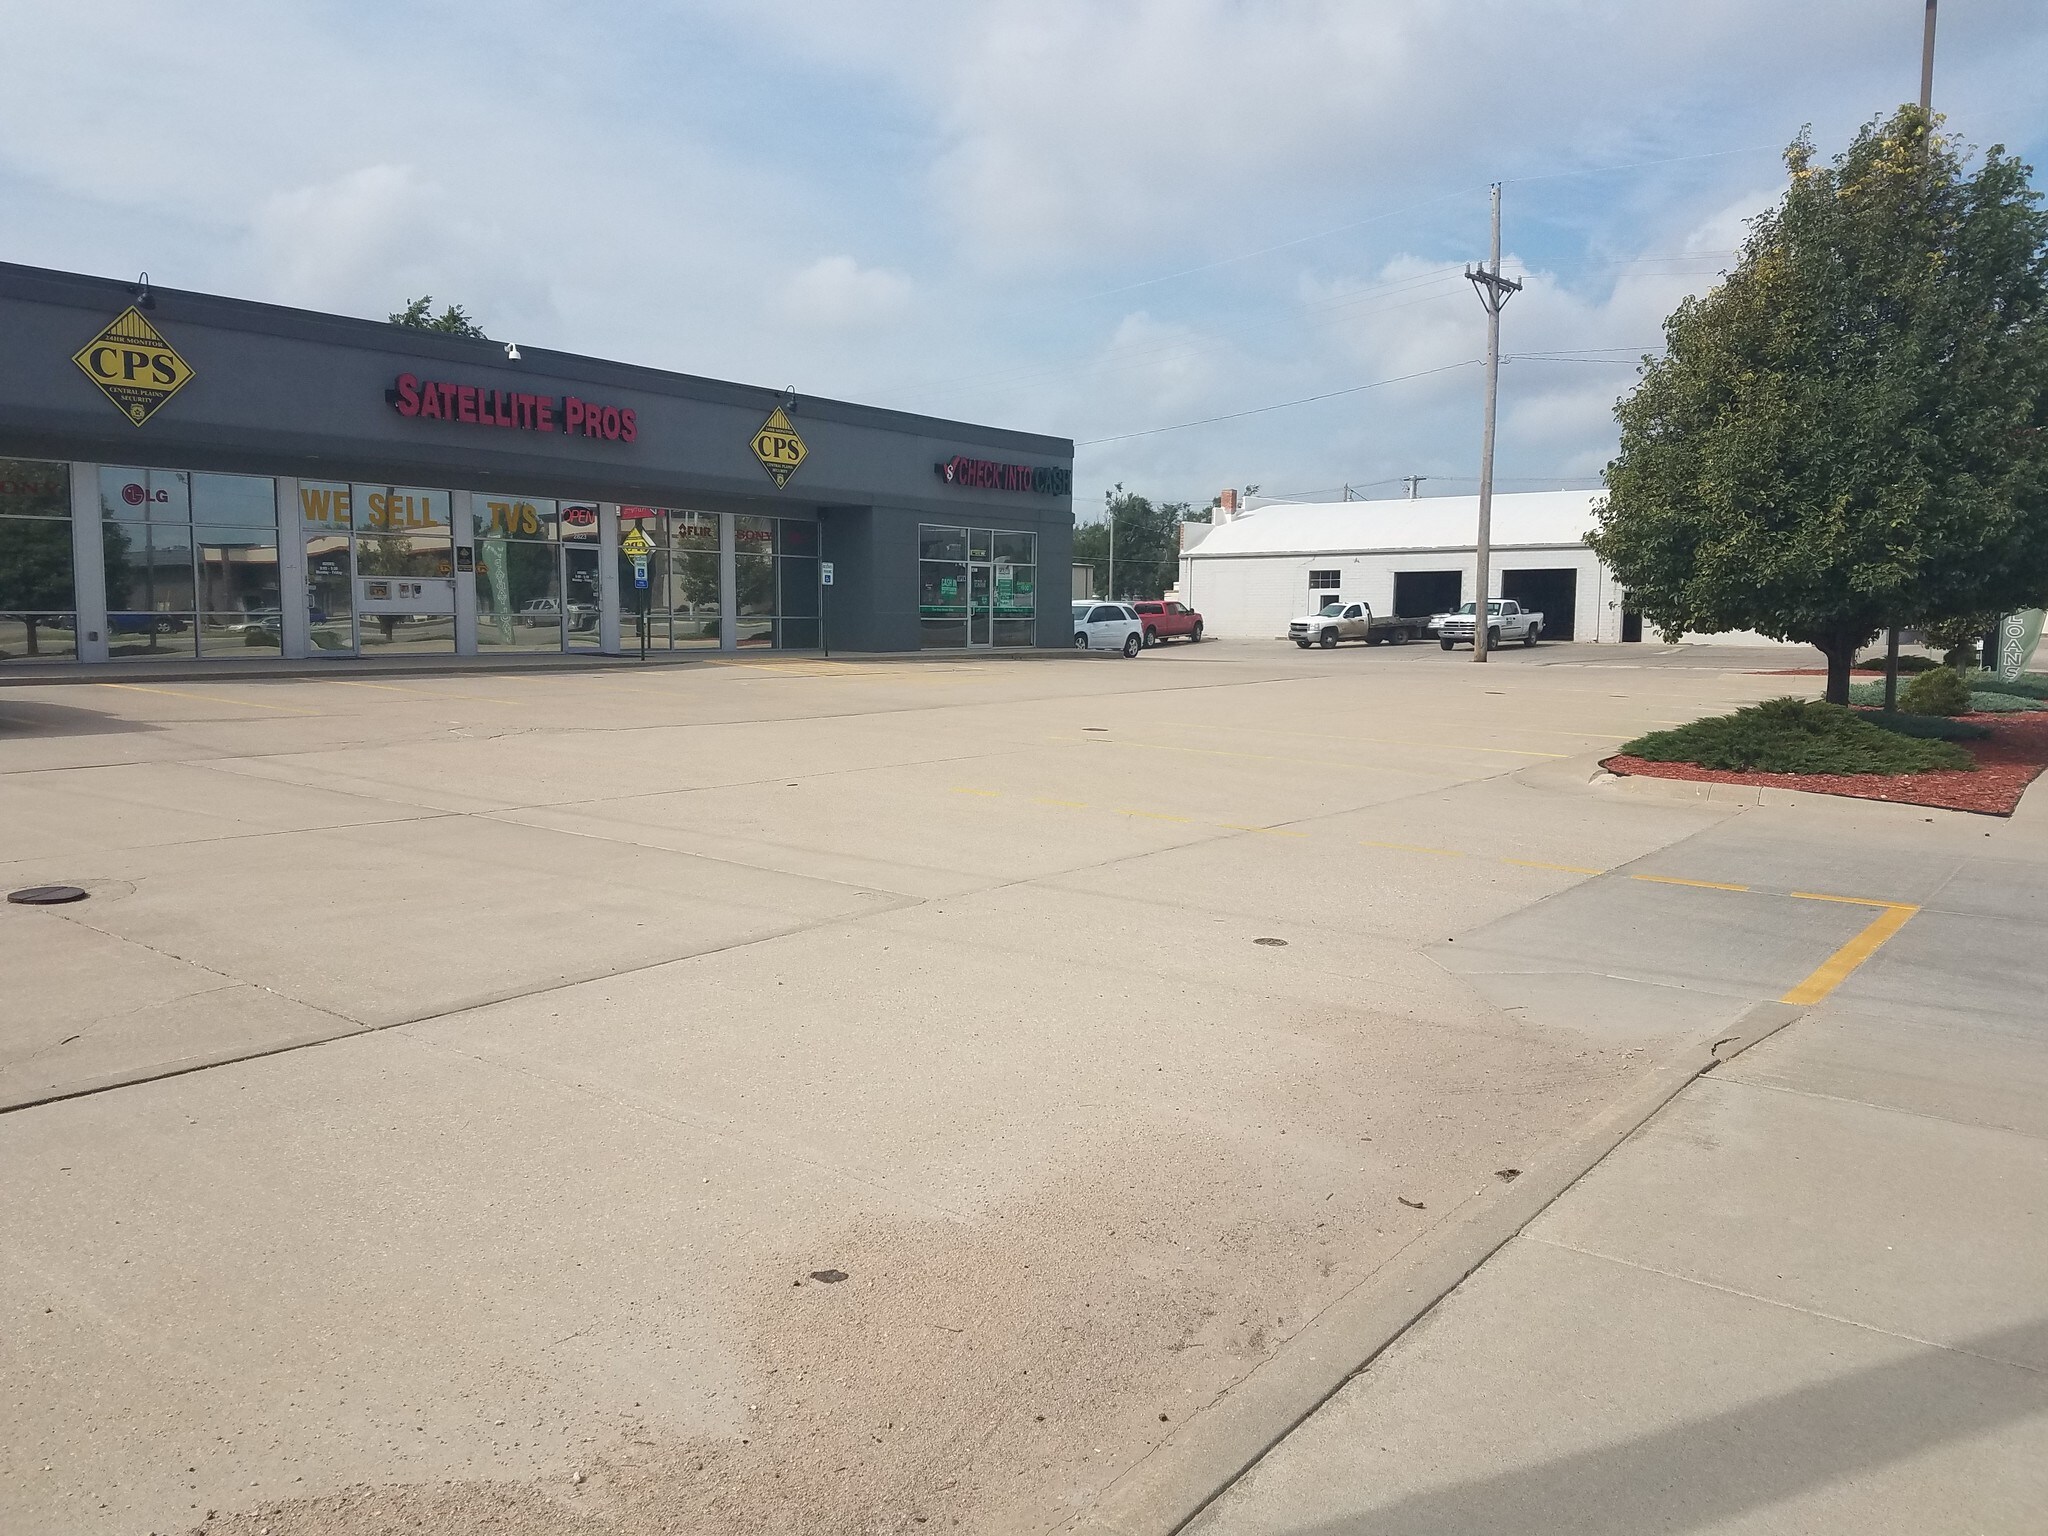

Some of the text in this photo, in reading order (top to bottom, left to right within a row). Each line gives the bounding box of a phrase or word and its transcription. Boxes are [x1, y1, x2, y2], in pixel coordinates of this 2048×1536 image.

[126, 336, 164, 348] MONITOR
[89, 346, 177, 385] CPS
[109, 386, 164, 398] CENTRAL PLAINS
[121, 395, 153, 404] SECURITY
[396, 373, 639, 443] SATELLITE PROS
[757, 435, 800, 461] CPS
[959, 456, 1072, 496] CHECK INTO CASH
[146, 489, 169, 503] LG
[300, 488, 538, 535] WE SELL TVS
[562, 508, 595, 524] OPEN
[687, 526, 712, 538] FLIR
[2003, 615, 2024, 679] LOANS
